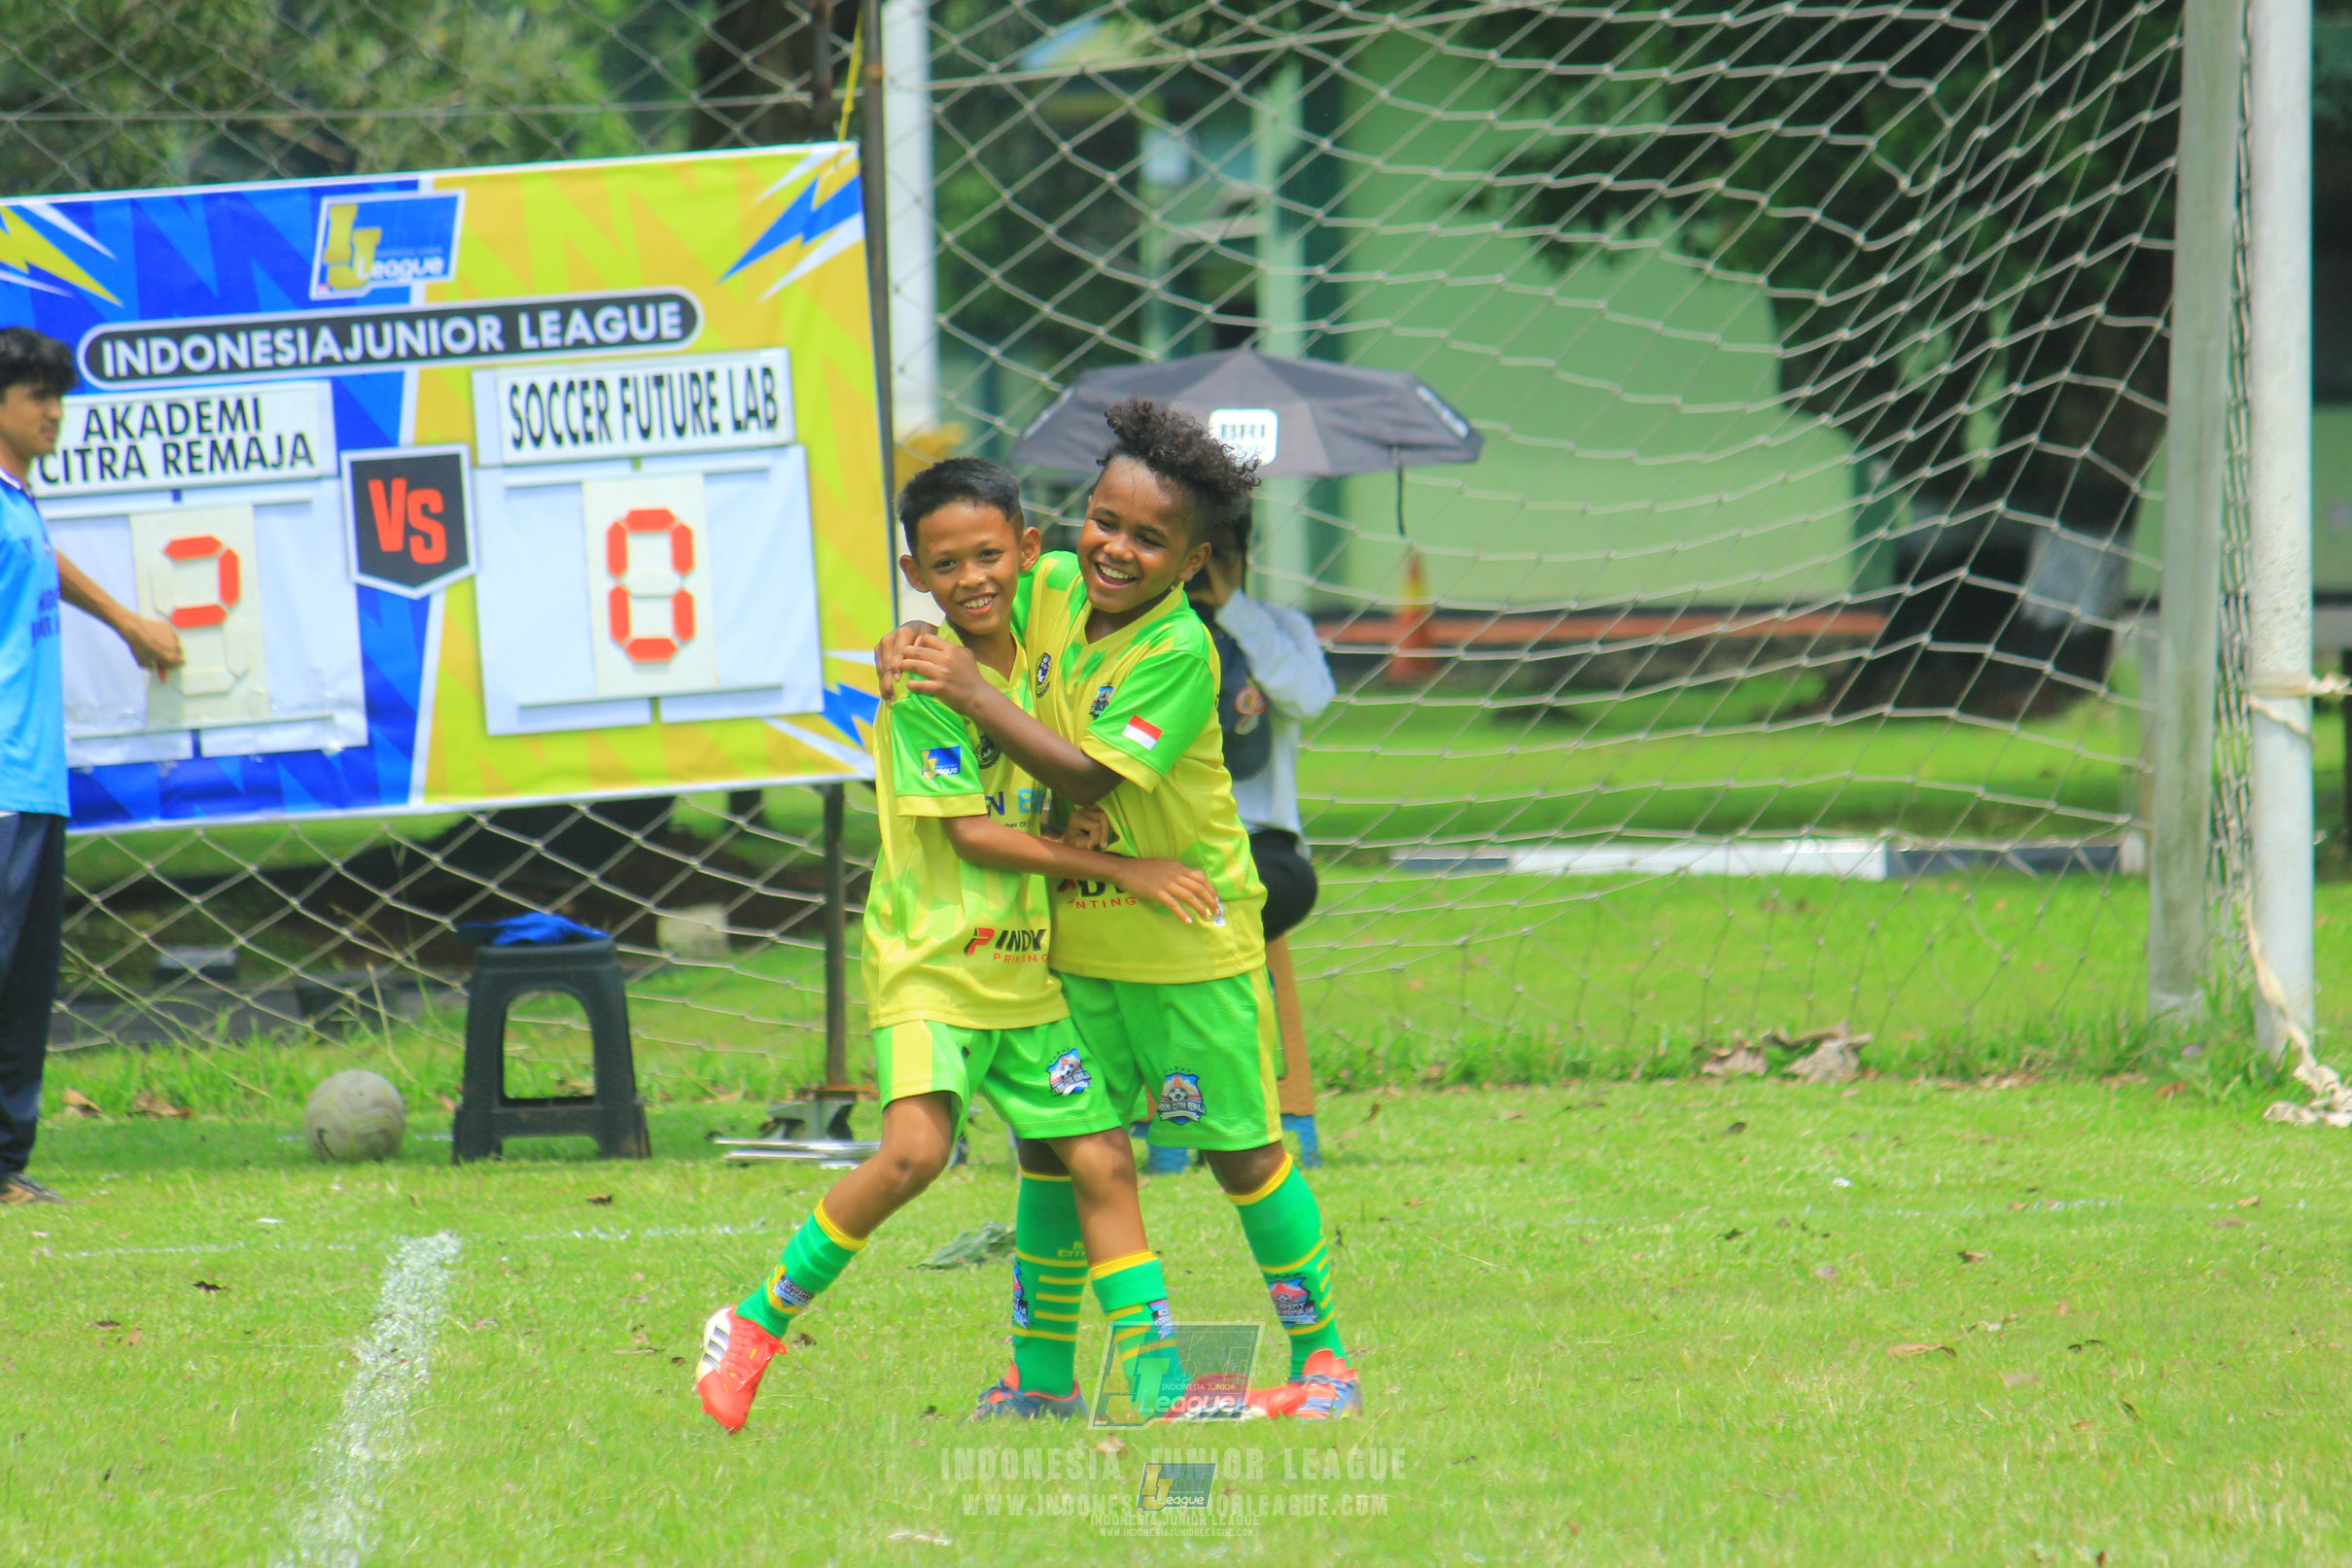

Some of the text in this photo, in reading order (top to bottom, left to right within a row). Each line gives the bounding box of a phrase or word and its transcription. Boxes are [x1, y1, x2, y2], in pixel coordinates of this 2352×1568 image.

[518, 300, 683, 348] LEAGUE
[83, 397, 263, 442] AKADEMI
[509, 366, 778, 450] SOCCER FUTURE LAB
[39, 433, 315, 484] CITRA REMAJA
